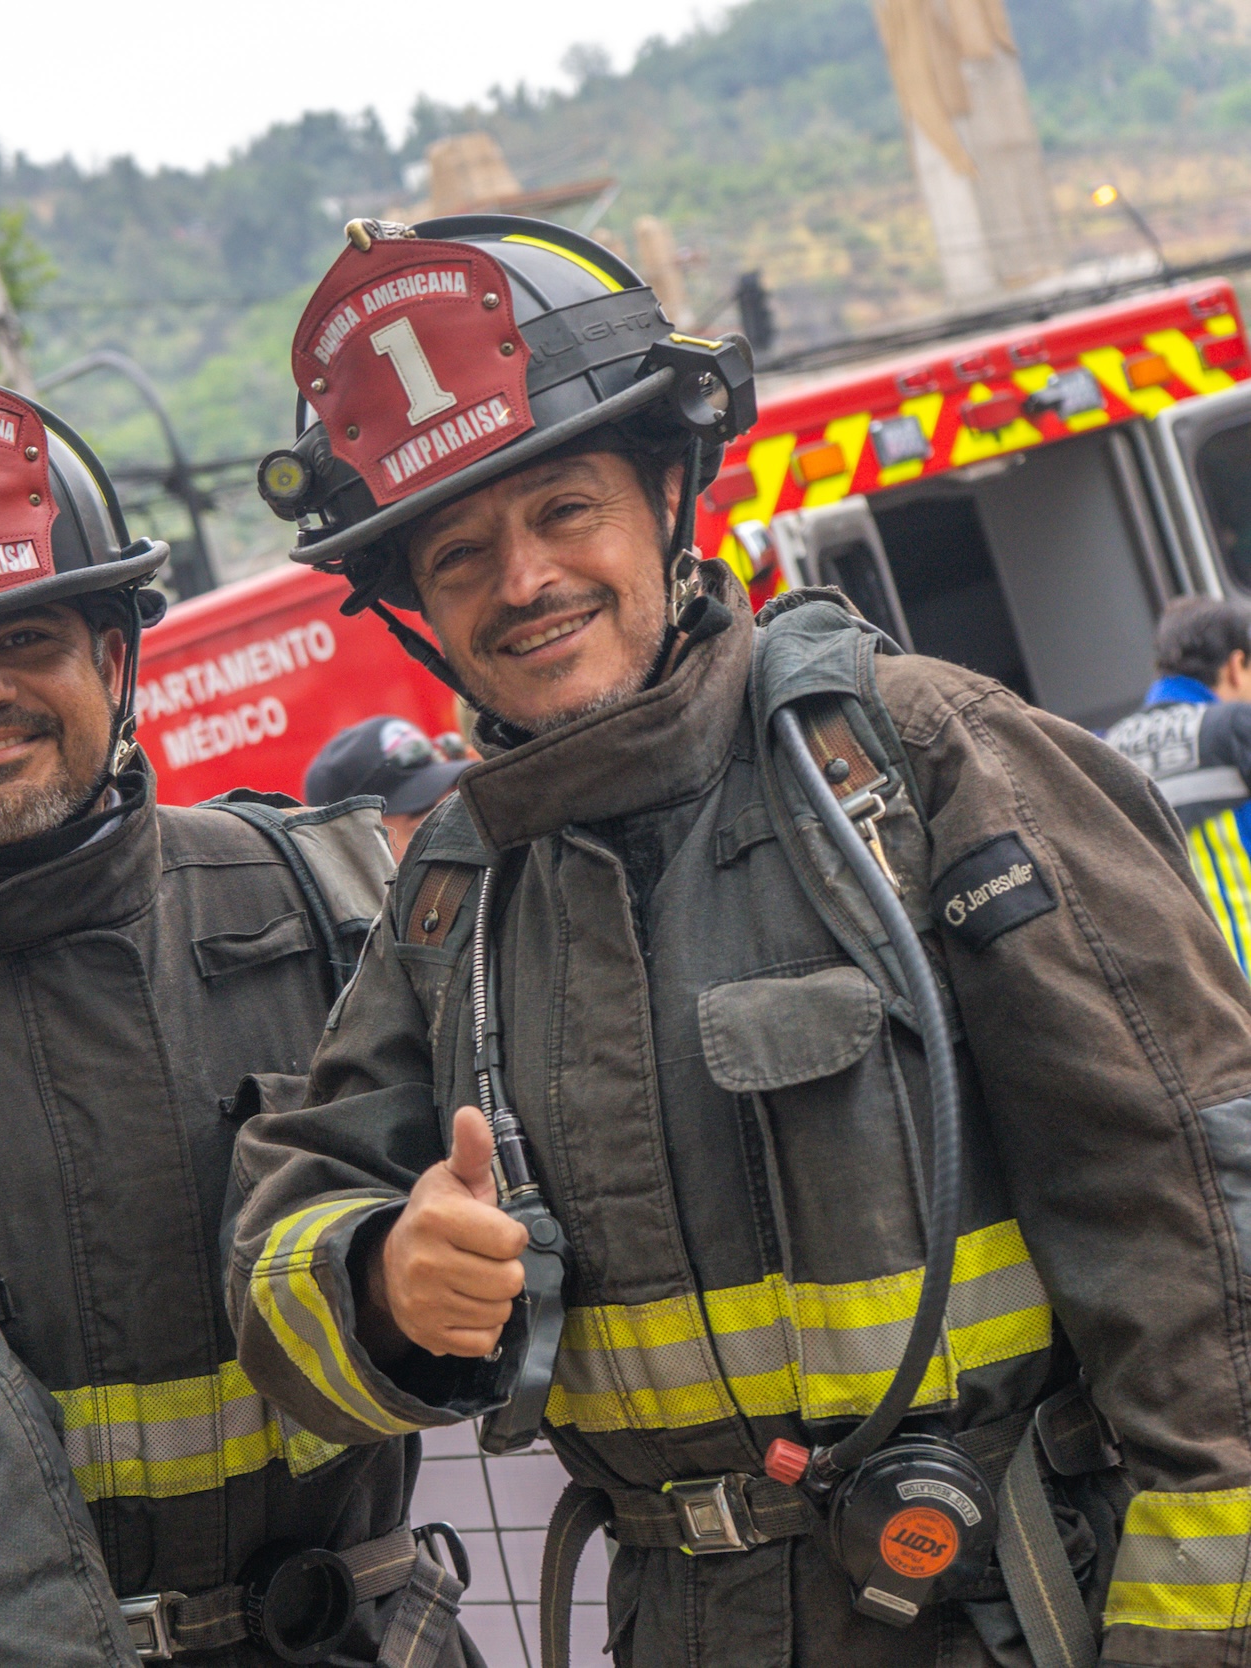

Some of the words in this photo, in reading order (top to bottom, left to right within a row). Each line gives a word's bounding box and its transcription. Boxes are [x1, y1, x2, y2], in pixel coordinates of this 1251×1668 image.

[313, 305, 361, 366] BOMBA
[361, 271, 467, 315] AMERICANA
[531, 310, 651, 365] LIGHT
[369, 316, 457, 427] 1
[383, 399, 510, 484] VALPARAISO
[135, 619, 337, 726] PARTAMENTO
[160, 696, 289, 771] MÉDICO
[966, 862, 1034, 912] Janesville
[902, 1484, 953, 1500] REGULATOR
[891, 1528, 948, 1557] SCOTT
